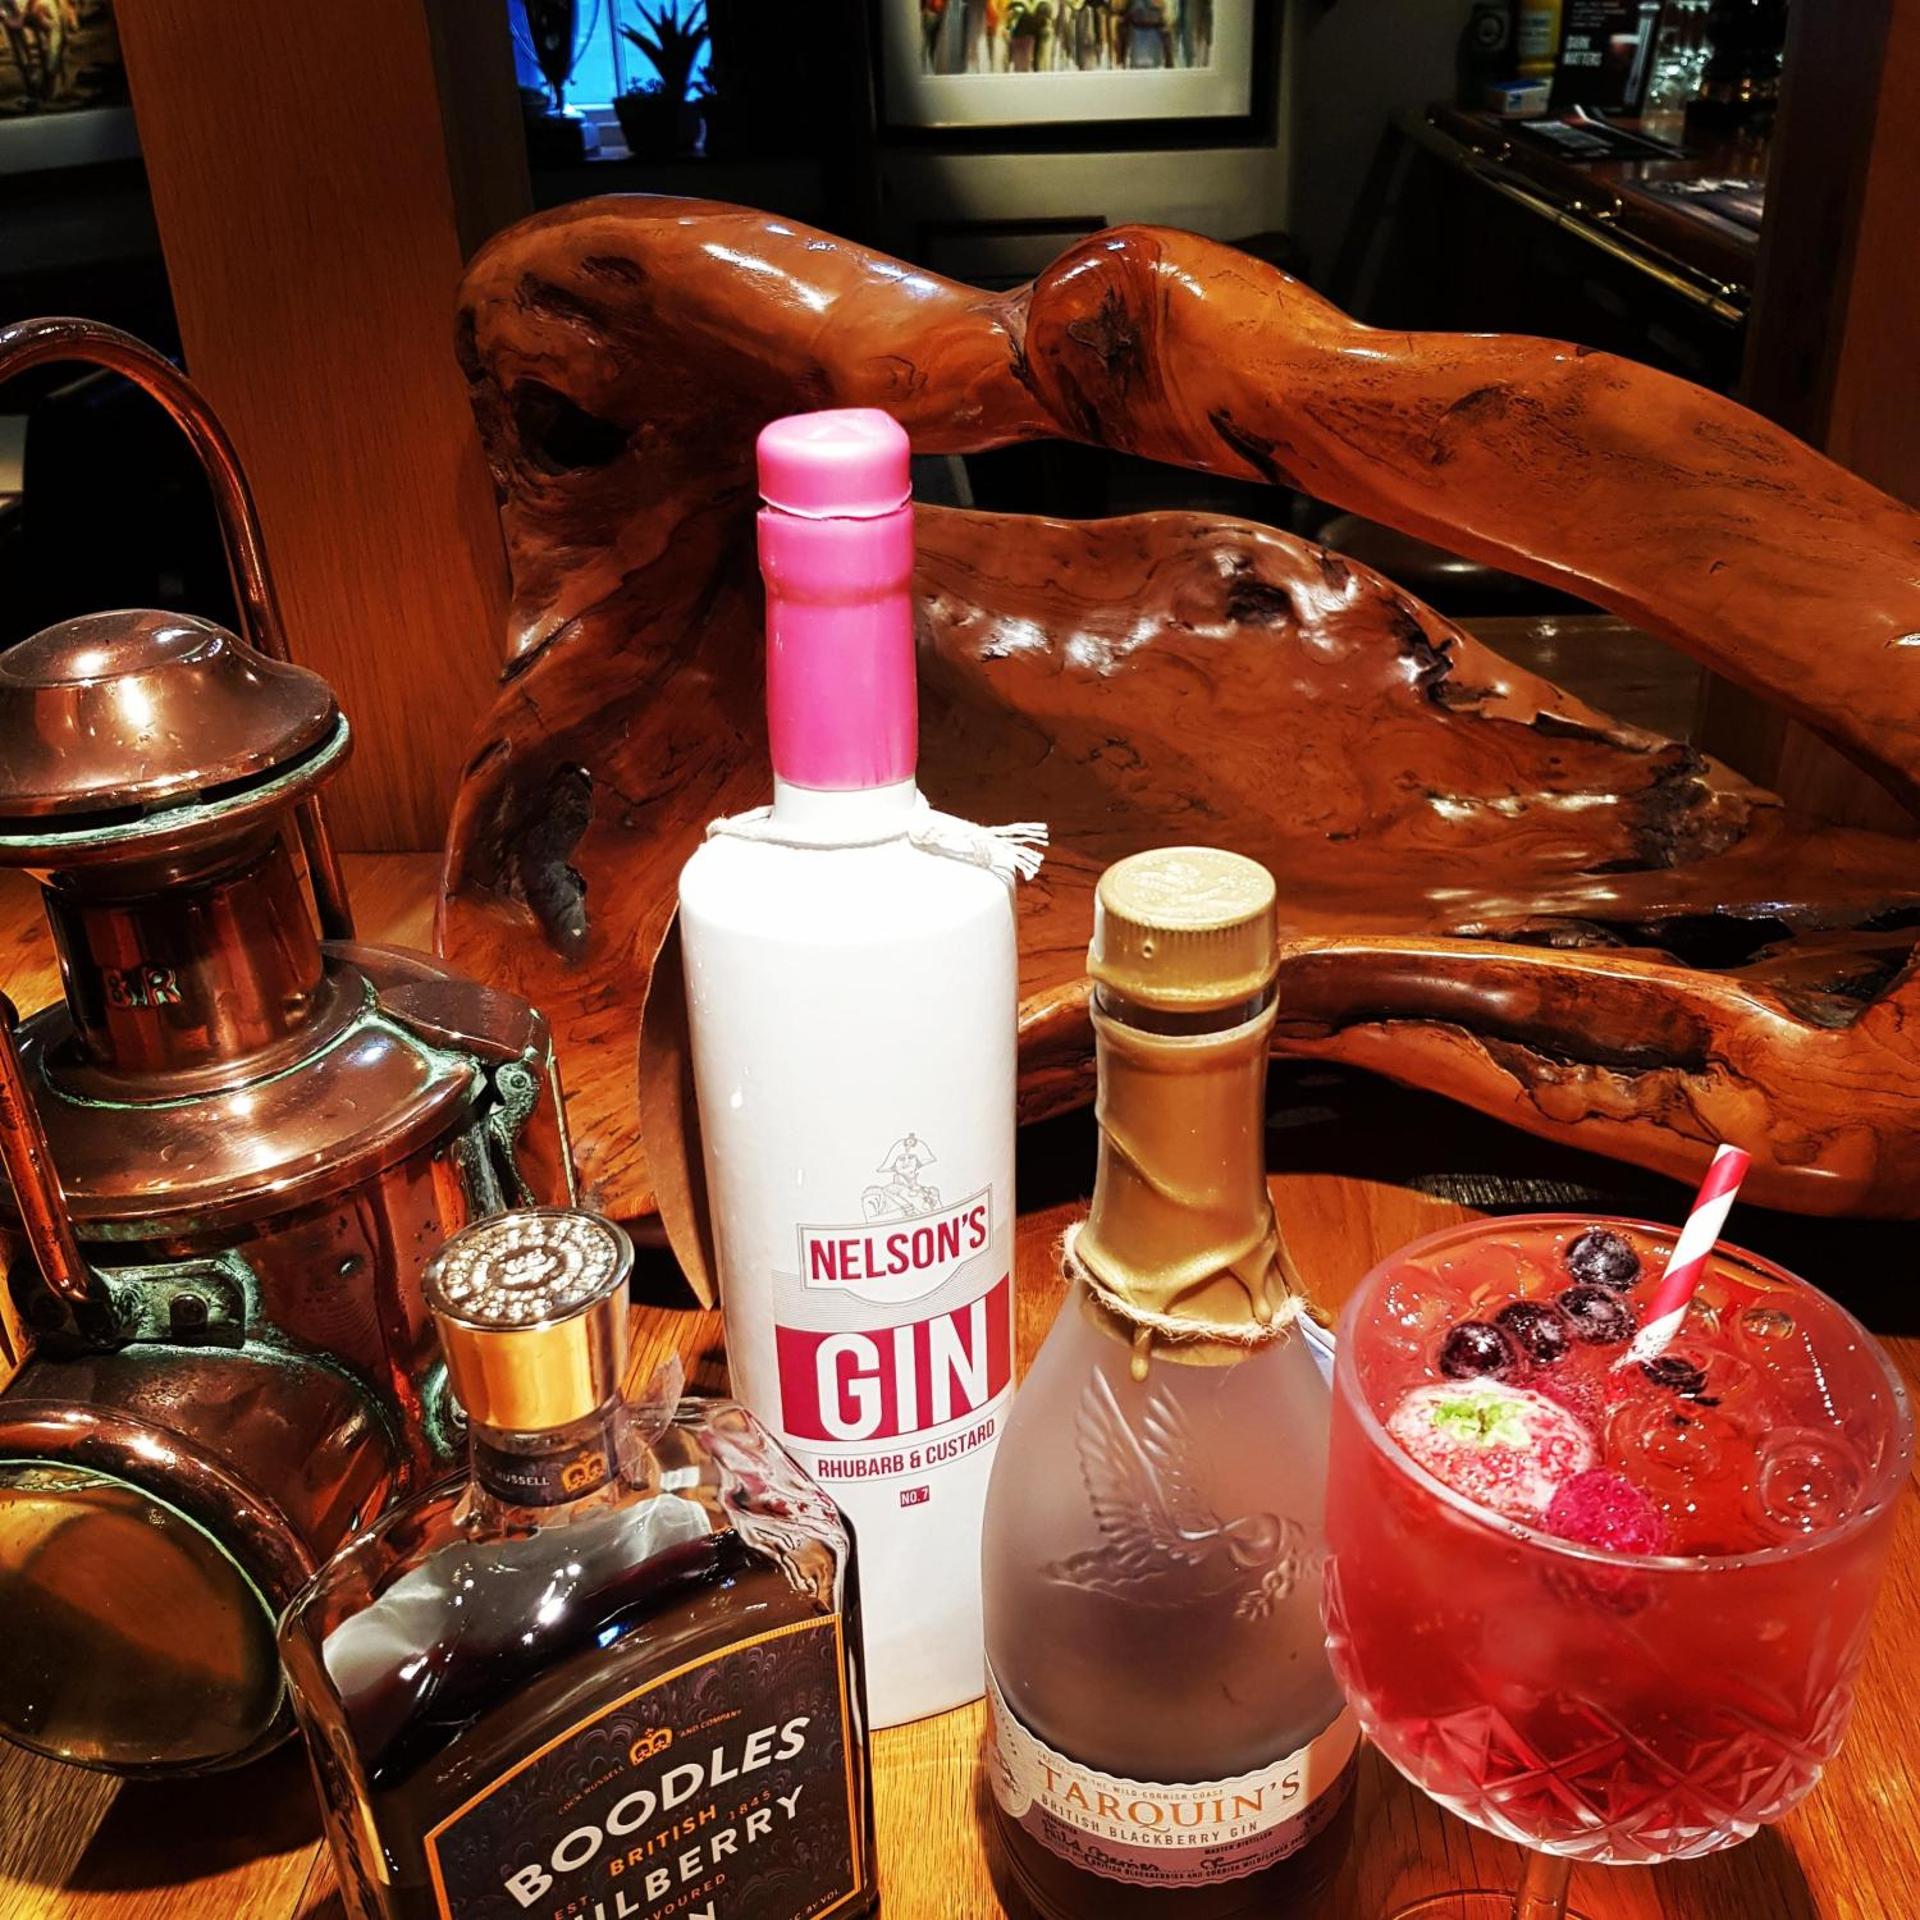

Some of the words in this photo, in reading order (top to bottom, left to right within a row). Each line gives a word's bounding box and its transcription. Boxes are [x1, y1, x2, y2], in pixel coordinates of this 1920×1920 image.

[810, 1206, 987, 1280] NELSON'S
[815, 1296, 990, 1441] GIN
[818, 1453, 904, 1479] RHUBARB
[910, 1449, 922, 1468] &
[926, 1417, 996, 1465] CUSTARD
[505, 1717, 810, 1908] BOODLES
[728, 1790, 772, 1821] 1845
[1038, 1760, 1301, 1832] TARQUIN'S
[1041, 1793, 1100, 1833] BRITISH
[1109, 1826, 1220, 1846] BLACKBERRY
[1230, 1821, 1258, 1838] GIN
[1112, 1786, 1137, 1797] WILD
[1193, 1788, 1224, 1800] COAST
[574, 1784, 803, 1920] LBERRY
[610, 1804, 716, 1877] BRITISH
[645, 1873, 726, 1920] VOURED
